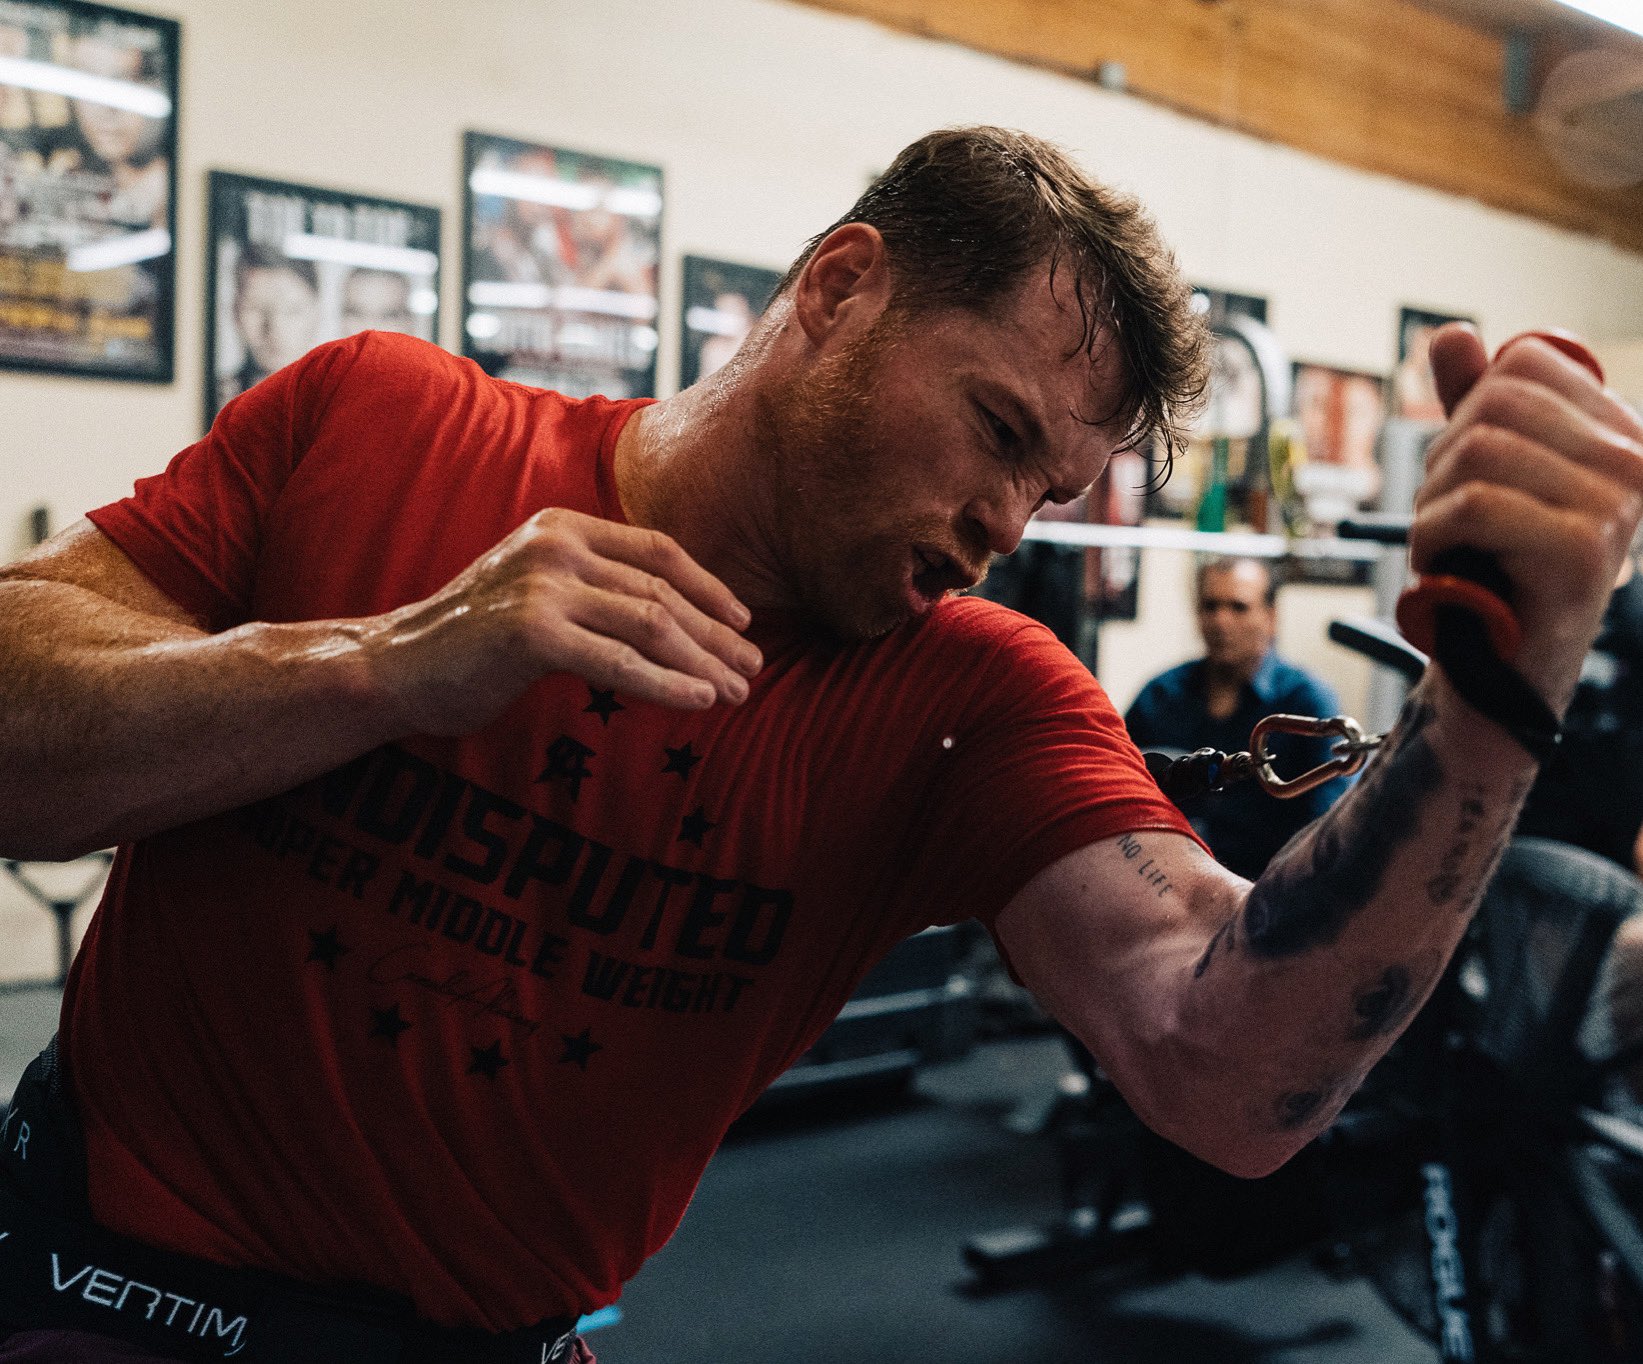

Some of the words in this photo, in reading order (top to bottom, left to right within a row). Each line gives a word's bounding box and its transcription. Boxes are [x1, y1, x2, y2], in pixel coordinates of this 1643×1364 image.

[286, 743, 795, 965] NDISPUTED
[1117, 833, 1143, 859] NO
[1138, 859, 1174, 898] LIFE
[388, 872, 568, 978] MIDDLE
[582, 950, 754, 1013] WEIGHT
